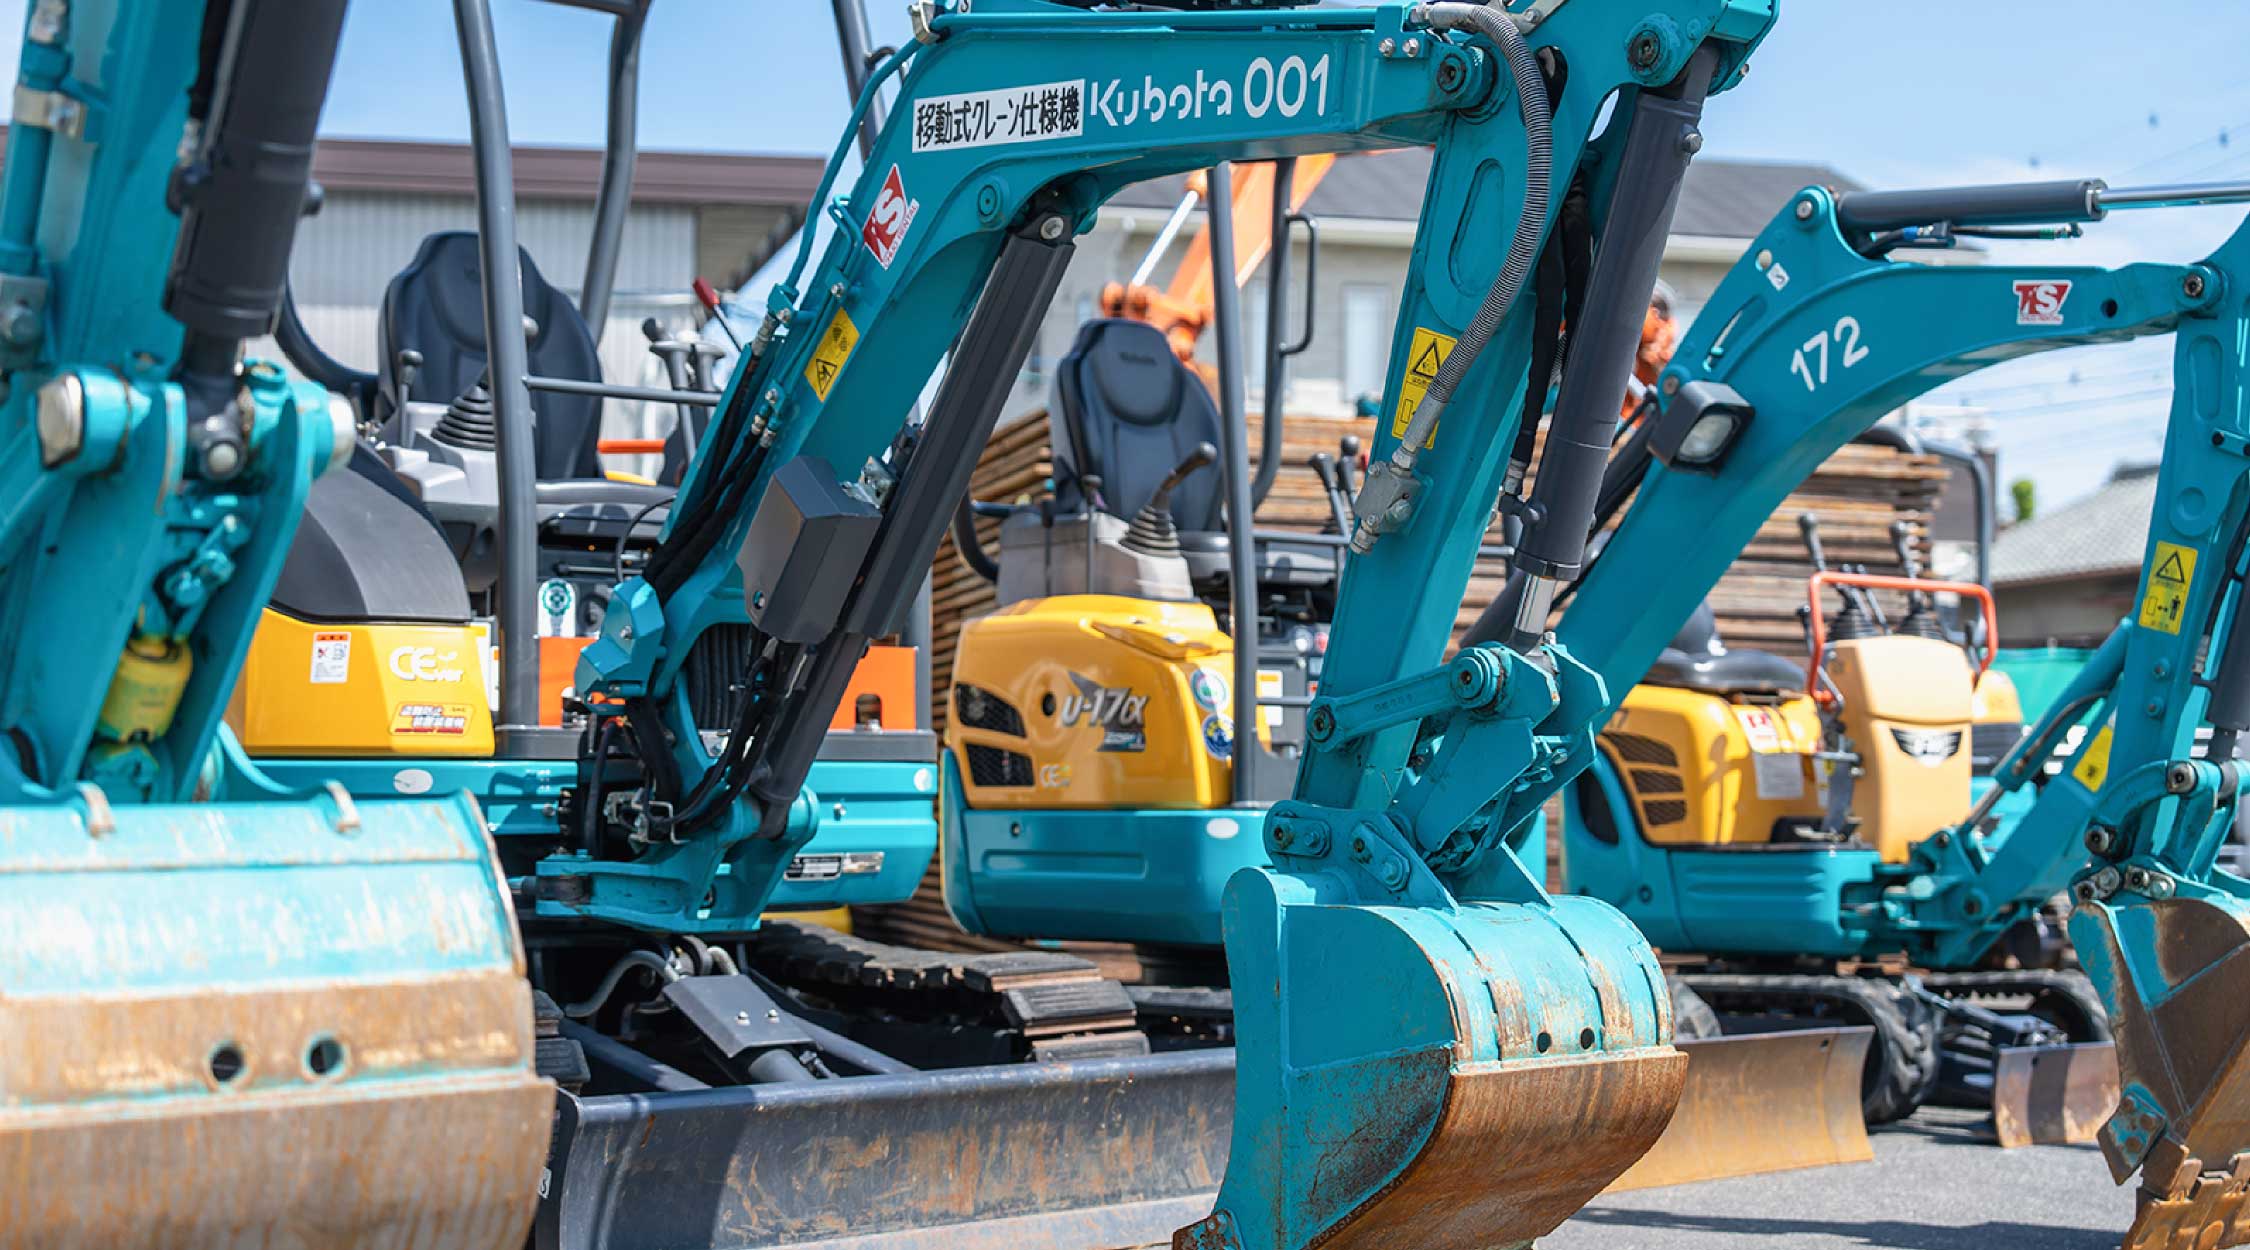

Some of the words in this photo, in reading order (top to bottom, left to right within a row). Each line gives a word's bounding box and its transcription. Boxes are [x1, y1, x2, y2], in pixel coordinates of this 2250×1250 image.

[916, 86, 1080, 148] 移動式クレーン仕様機
[1091, 69, 1232, 126] Kubota
[1243, 53, 1330, 118] 001
[1790, 316, 1870, 392] 172
